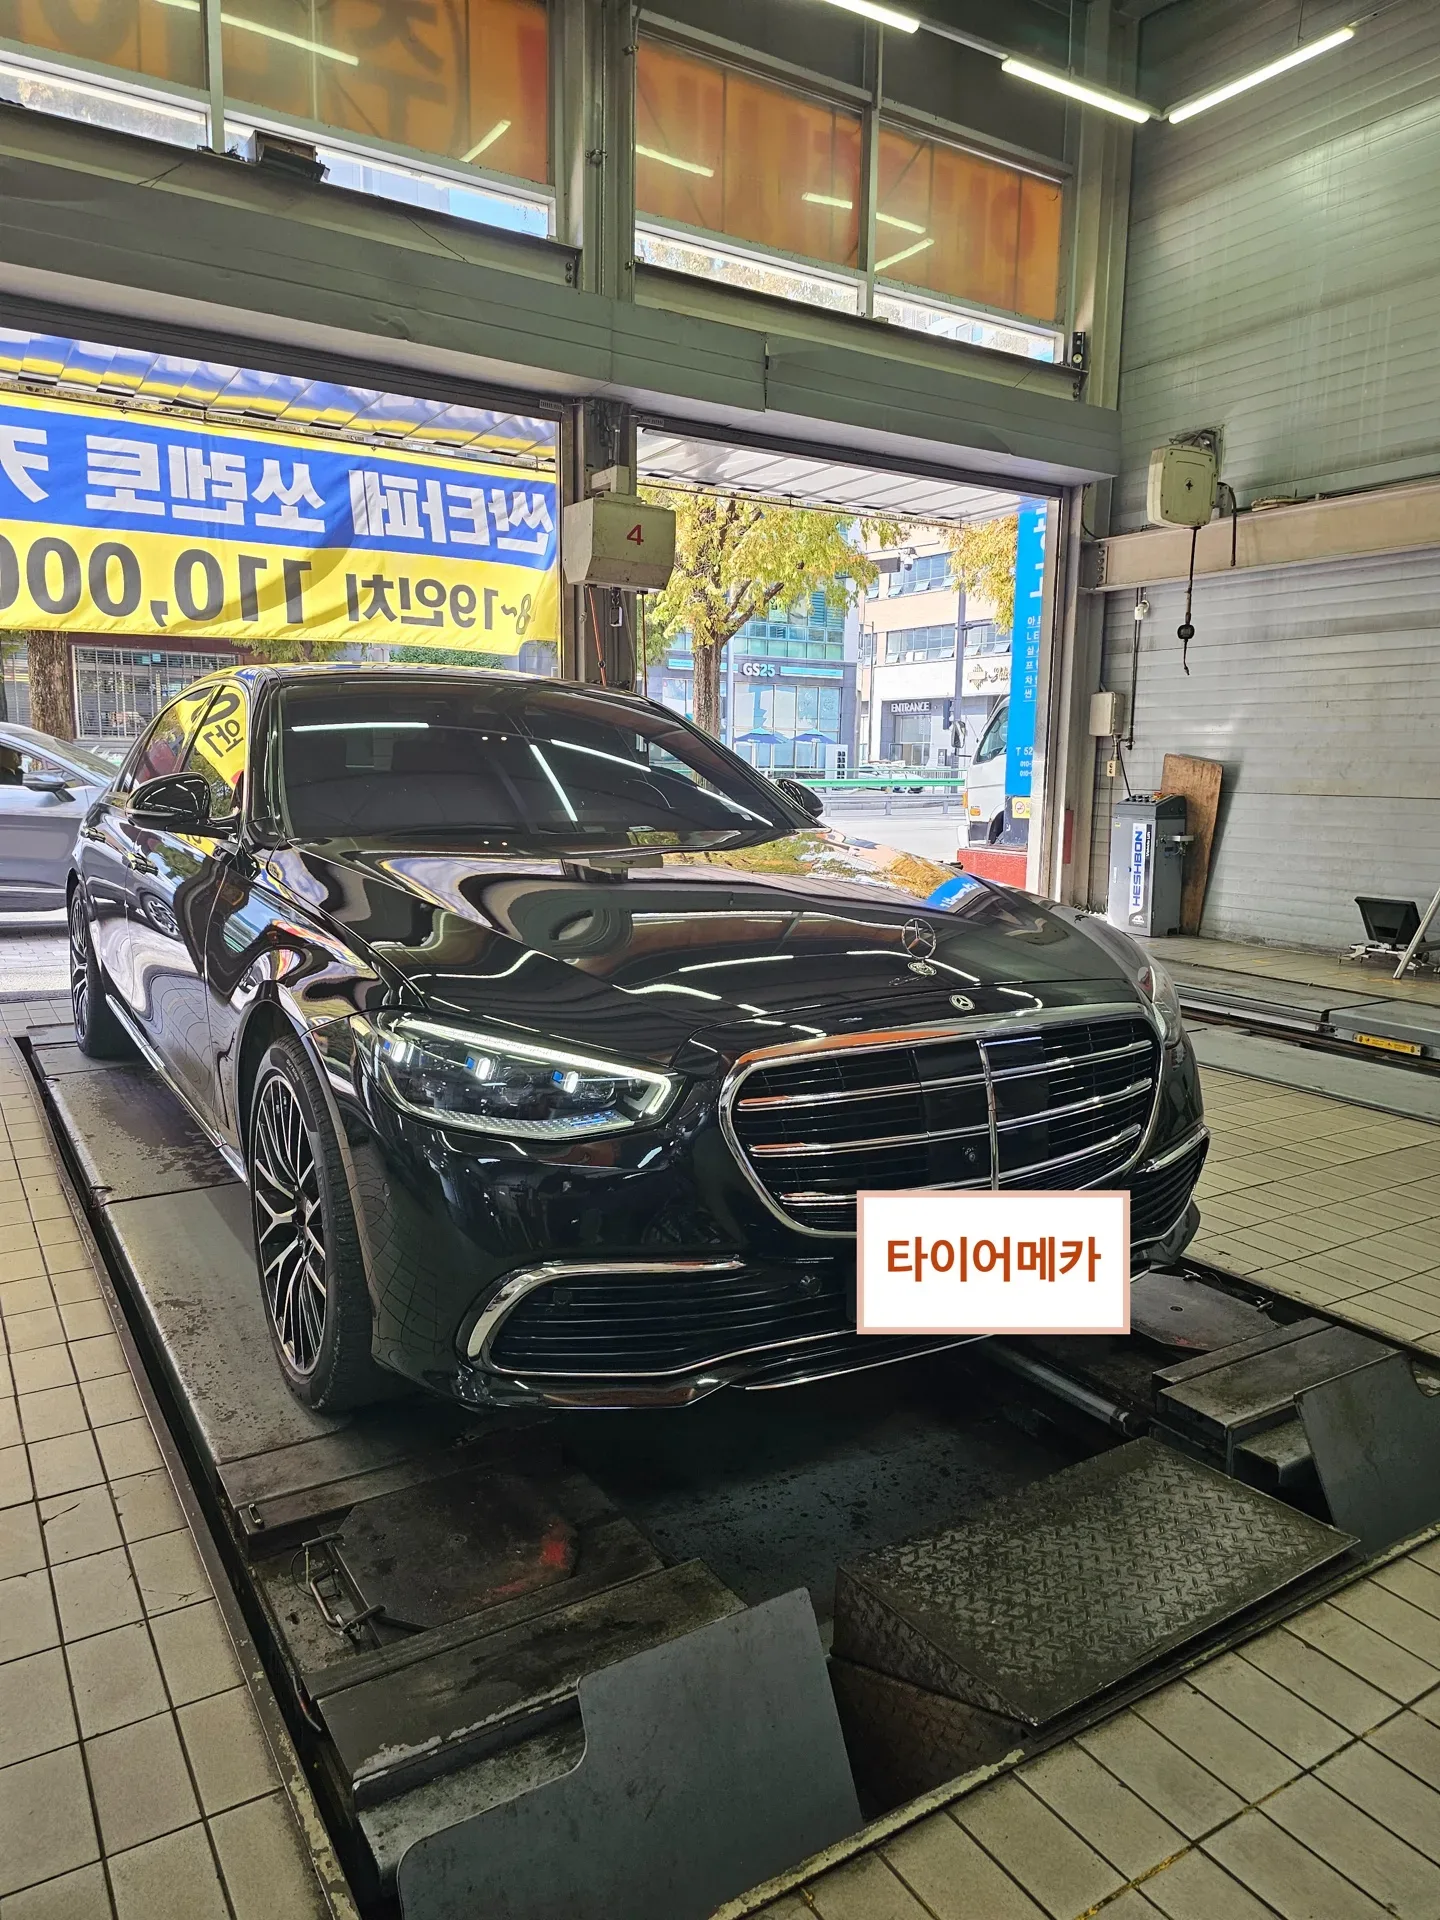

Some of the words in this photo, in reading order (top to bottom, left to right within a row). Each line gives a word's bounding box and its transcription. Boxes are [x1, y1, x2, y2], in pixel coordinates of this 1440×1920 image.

[626, 524, 645, 546] 4
[742, 662, 776, 677] GS25
[890, 701, 931, 713] ENTRANCE
[1132, 830, 1143, 907] HESHBON
